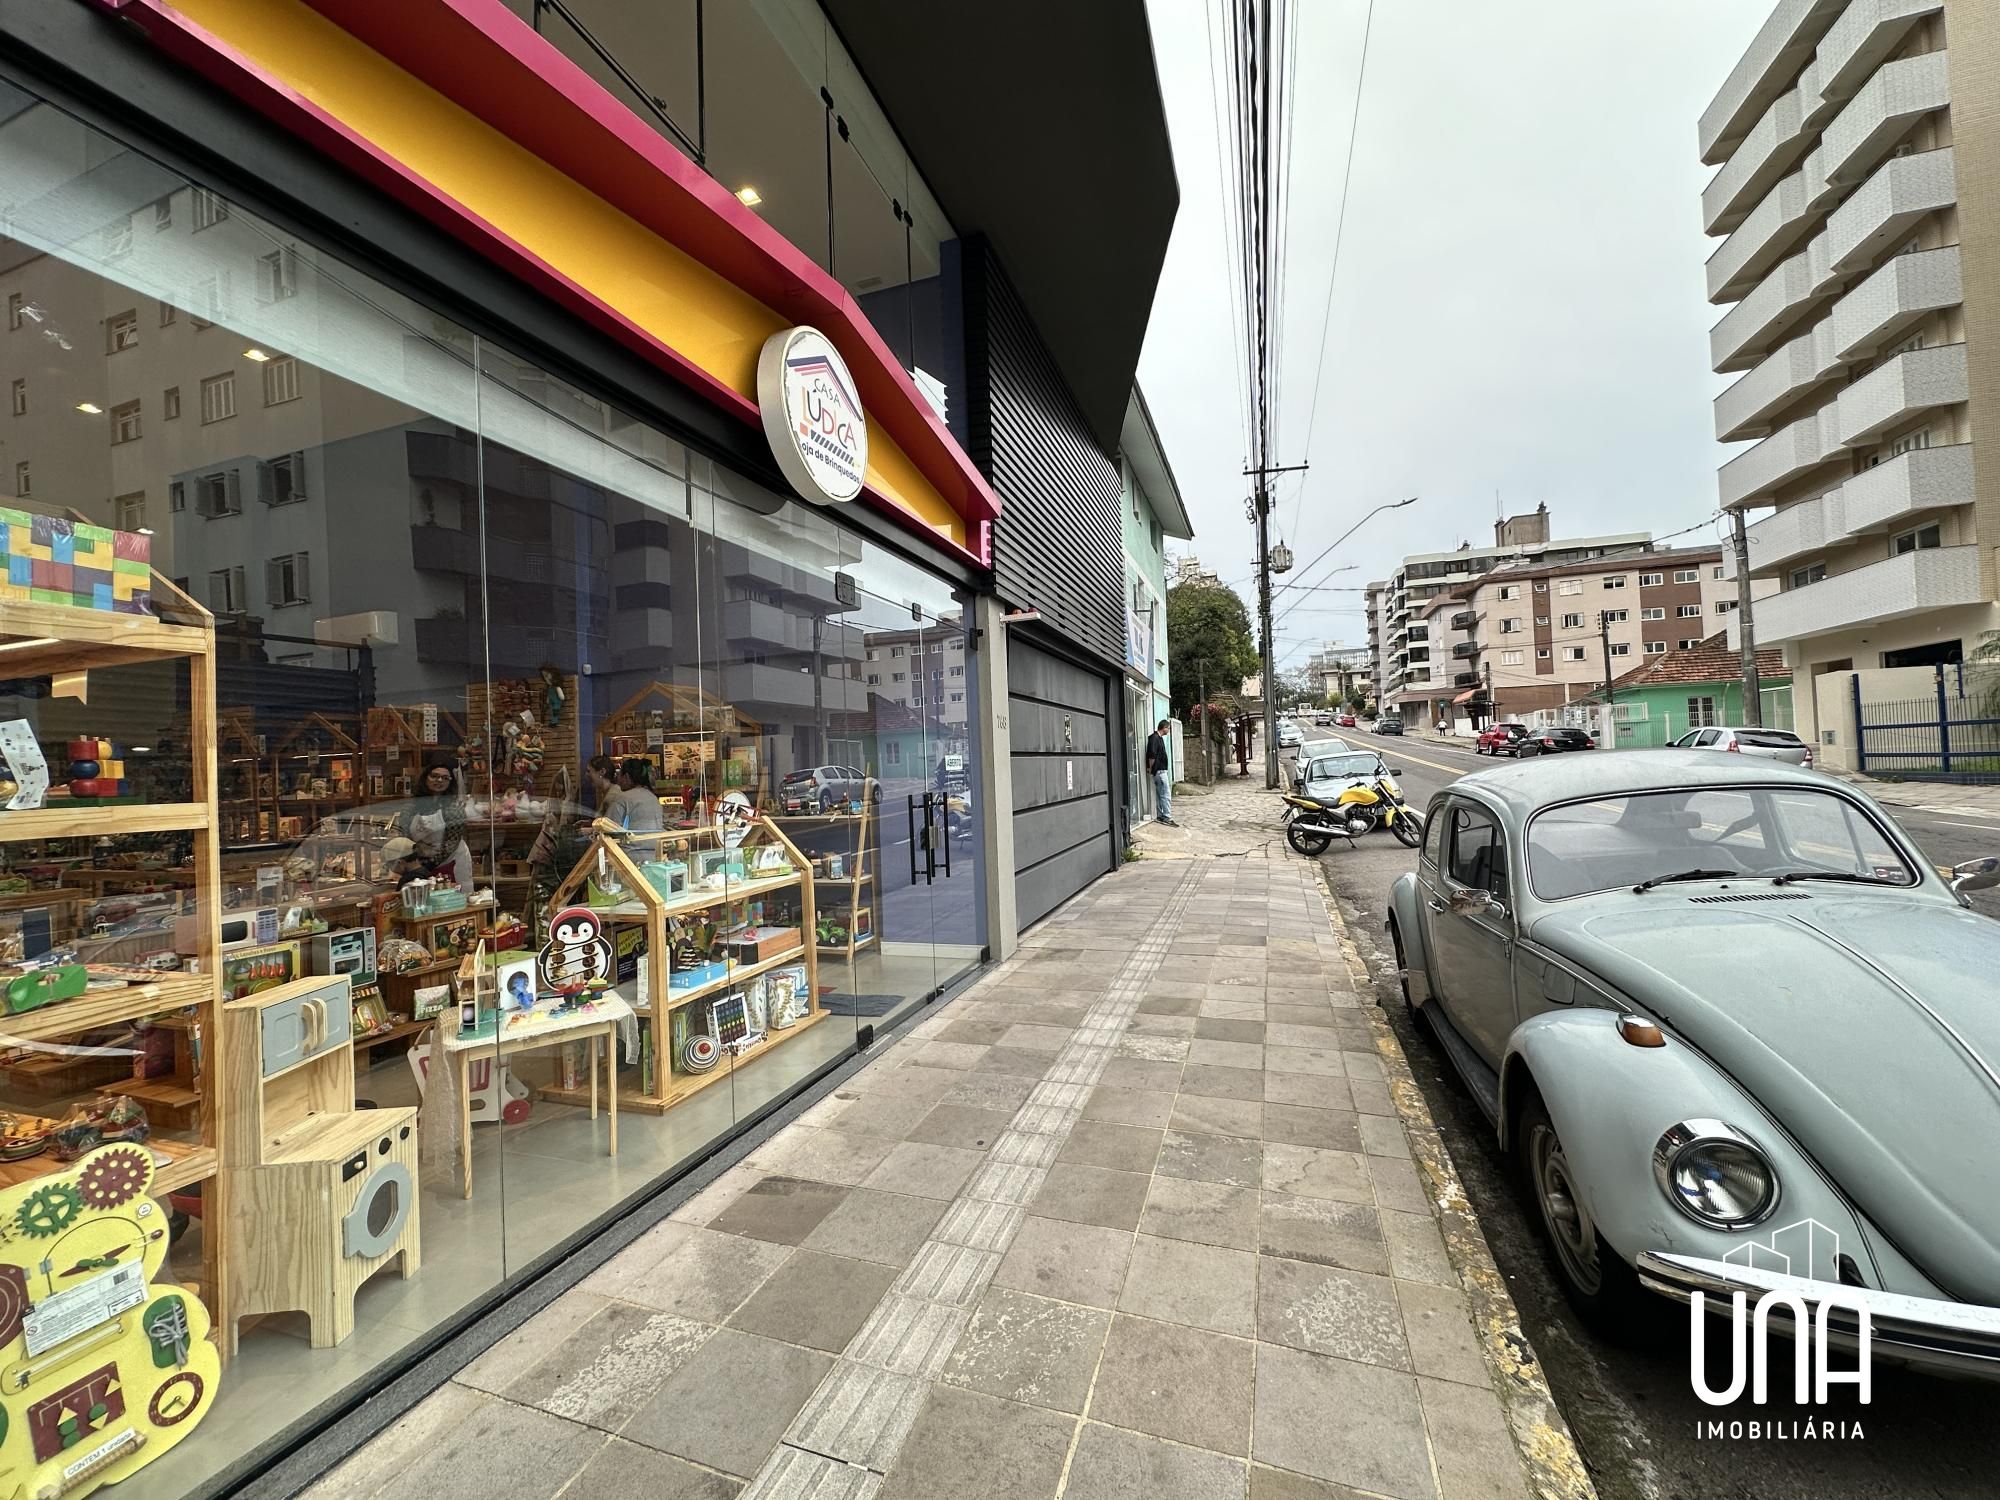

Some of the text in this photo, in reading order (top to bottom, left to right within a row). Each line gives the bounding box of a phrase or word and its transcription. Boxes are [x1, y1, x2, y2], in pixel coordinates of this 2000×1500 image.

[814, 378, 841, 408] CASA
[801, 442, 814, 456] oja
[815, 449, 824, 461] de
